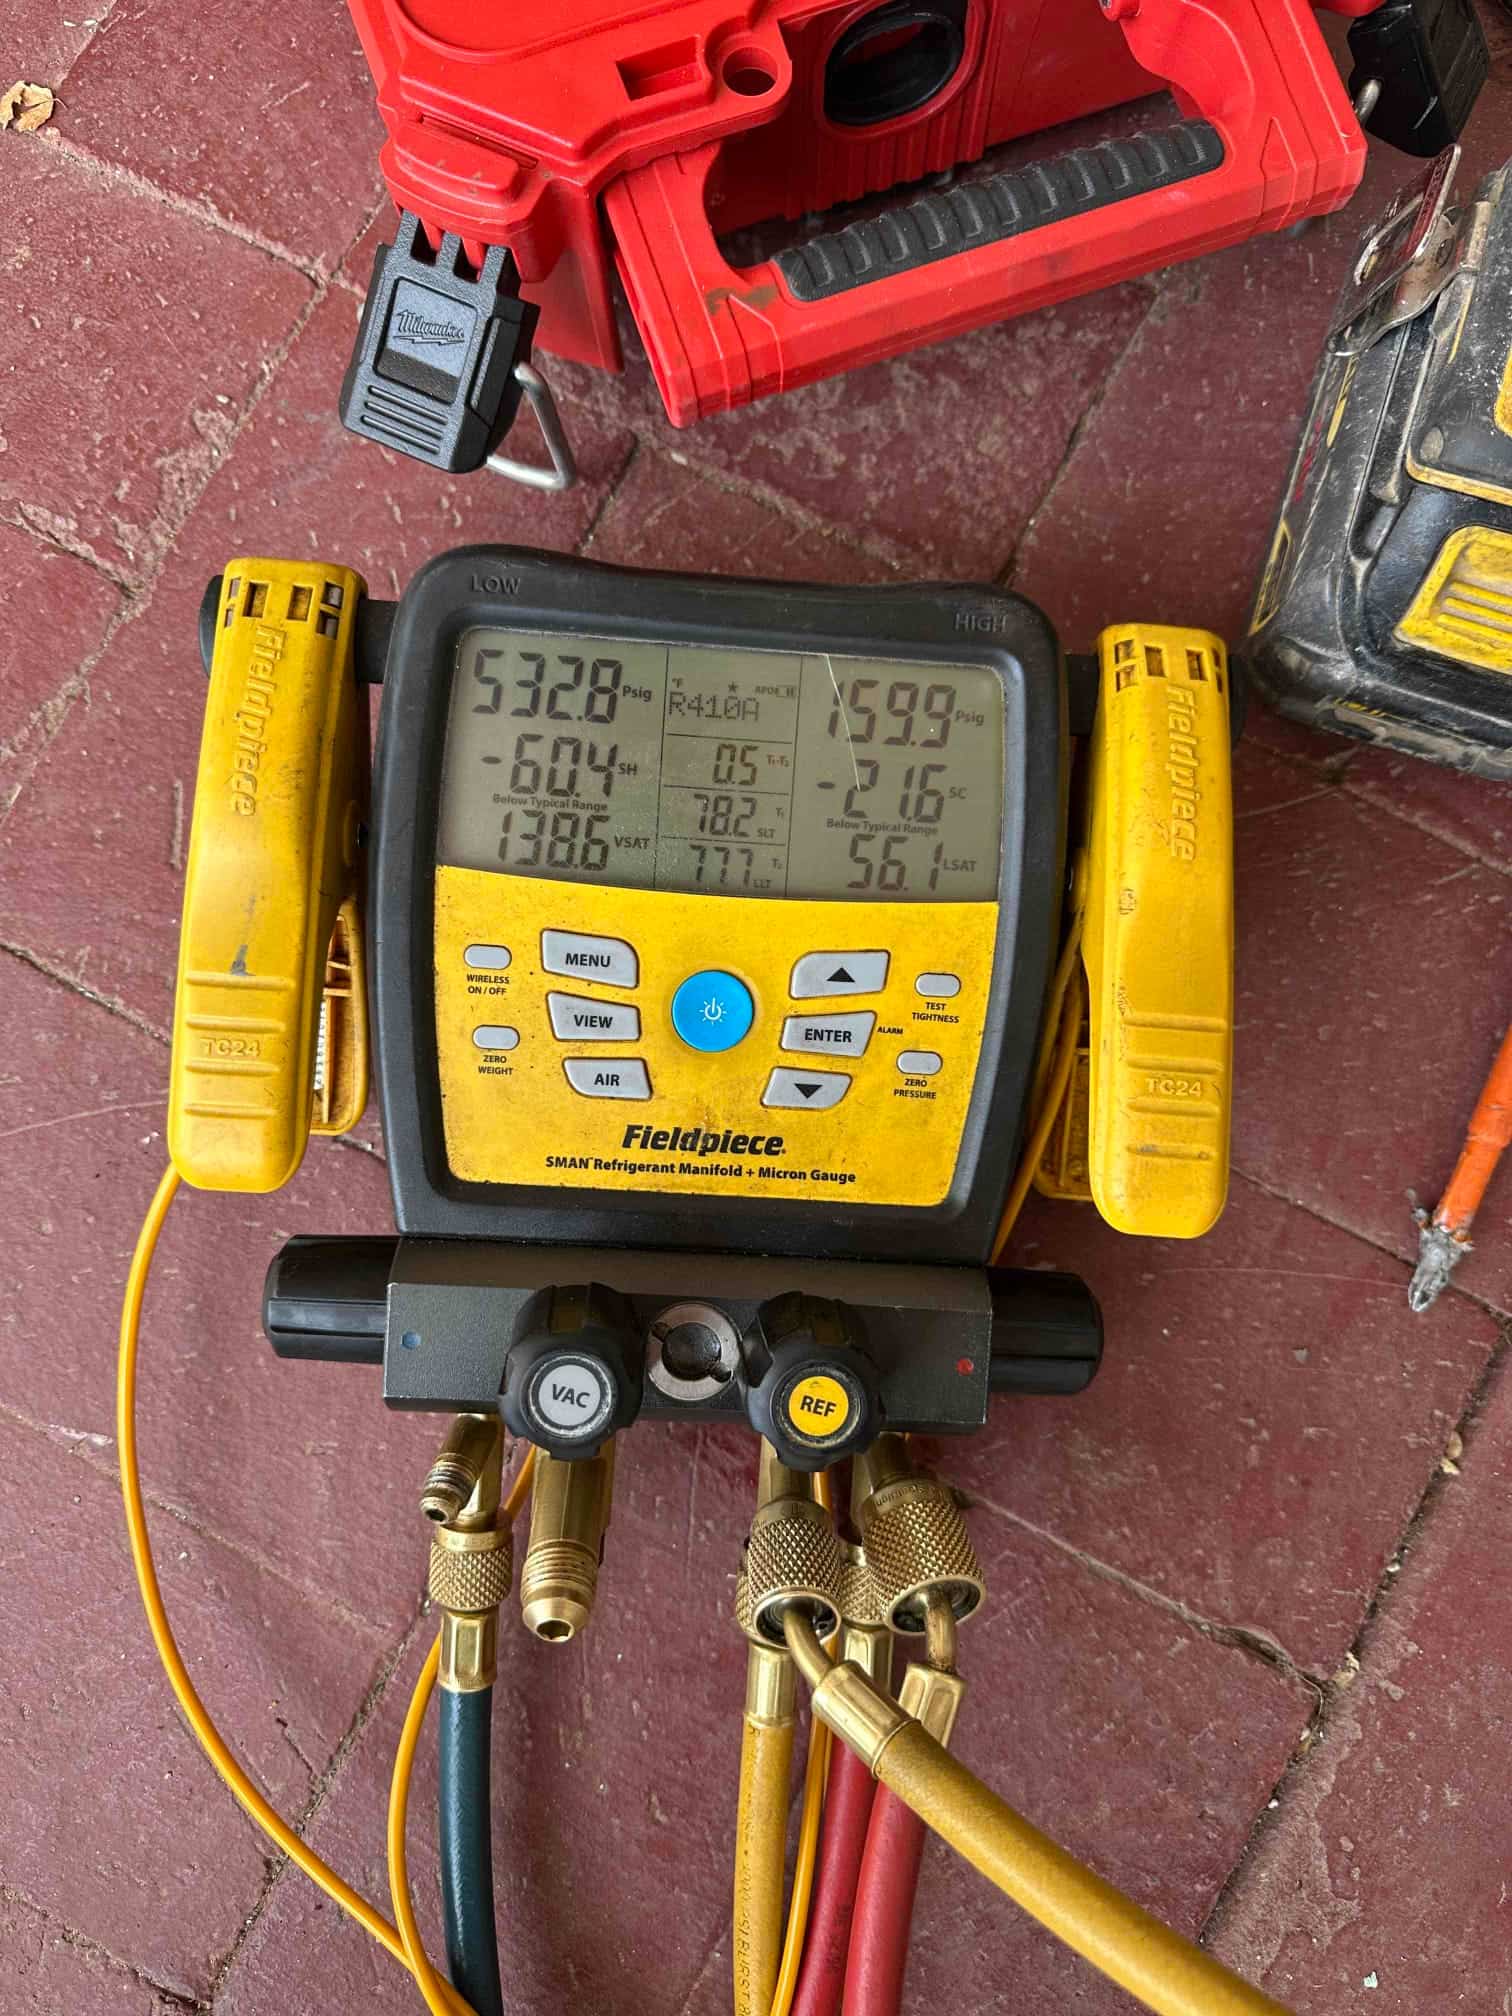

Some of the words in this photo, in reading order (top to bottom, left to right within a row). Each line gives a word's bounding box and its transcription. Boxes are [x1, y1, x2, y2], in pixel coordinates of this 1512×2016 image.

[396, 309, 465, 338] Milwaukee
[472, 574, 520, 594] LOW
[955, 612, 1006, 633] HIGH
[472, 649, 622, 723] 532.8
[622, 685, 652, 702] Psig
[669, 691, 760, 721] R410A
[828, 679, 956, 748] 159.9
[956, 710, 985, 726] Psig
[234, 624, 287, 816] Fieldpiece
[481, 733, 618, 798] -60.4
[617, 762, 638, 776] SH
[713, 743, 760, 786] 0.5
[1166, 683, 1200, 861] Fieldpiece
[817, 759, 947, 823] -21.6
[949, 787, 968, 799] SC
[493, 793, 528, 806] Below
[530, 795, 569, 809] Typical
[572, 799, 608, 812] Range
[694, 793, 757, 838] 78.2
[757, 828, 775, 839] SLT
[827, 818, 860, 830] Below
[863, 820, 900, 833] Typical
[904, 823, 938, 836] Range
[498, 809, 610, 871] 138.6
[615, 835, 650, 849] VSAT
[847, 833, 943, 891] 56.1
[943, 858, 977, 872] LSAT
[565, 952, 611, 968] MENU
[466, 974, 510, 984] WIRELESS
[467, 986, 484, 995] ON
[488, 987, 507, 996] OFF
[926, 1002, 947, 1011] TEST
[573, 1014, 613, 1029] VIEW
[912, 1012, 960, 1023] TIGHTNESS
[804, 1028, 853, 1043] ENTER
[877, 1026, 904, 1036] ALARM
[201, 1038, 262, 1058] TC24
[482, 1055, 507, 1064] ZERO
[478, 1066, 514, 1075] WEIGHT
[593, 1073, 621, 1087] AIR
[904, 1078, 928, 1088] ZERO
[1144, 1077, 1203, 1098] TC24
[893, 1089, 937, 1099] PRESSURE
[622, 1124, 785, 1157] Fieldpiece
[593, 1158, 675, 1174] Refrigerant
[678, 1162, 743, 1177] Manifold
[746, 1169, 754, 1177] +
[758, 1166, 807, 1180] Micron
[810, 1169, 857, 1185] Gauge
[551, 1383, 591, 1408] VAC
[800, 1395, 837, 1418] REF
